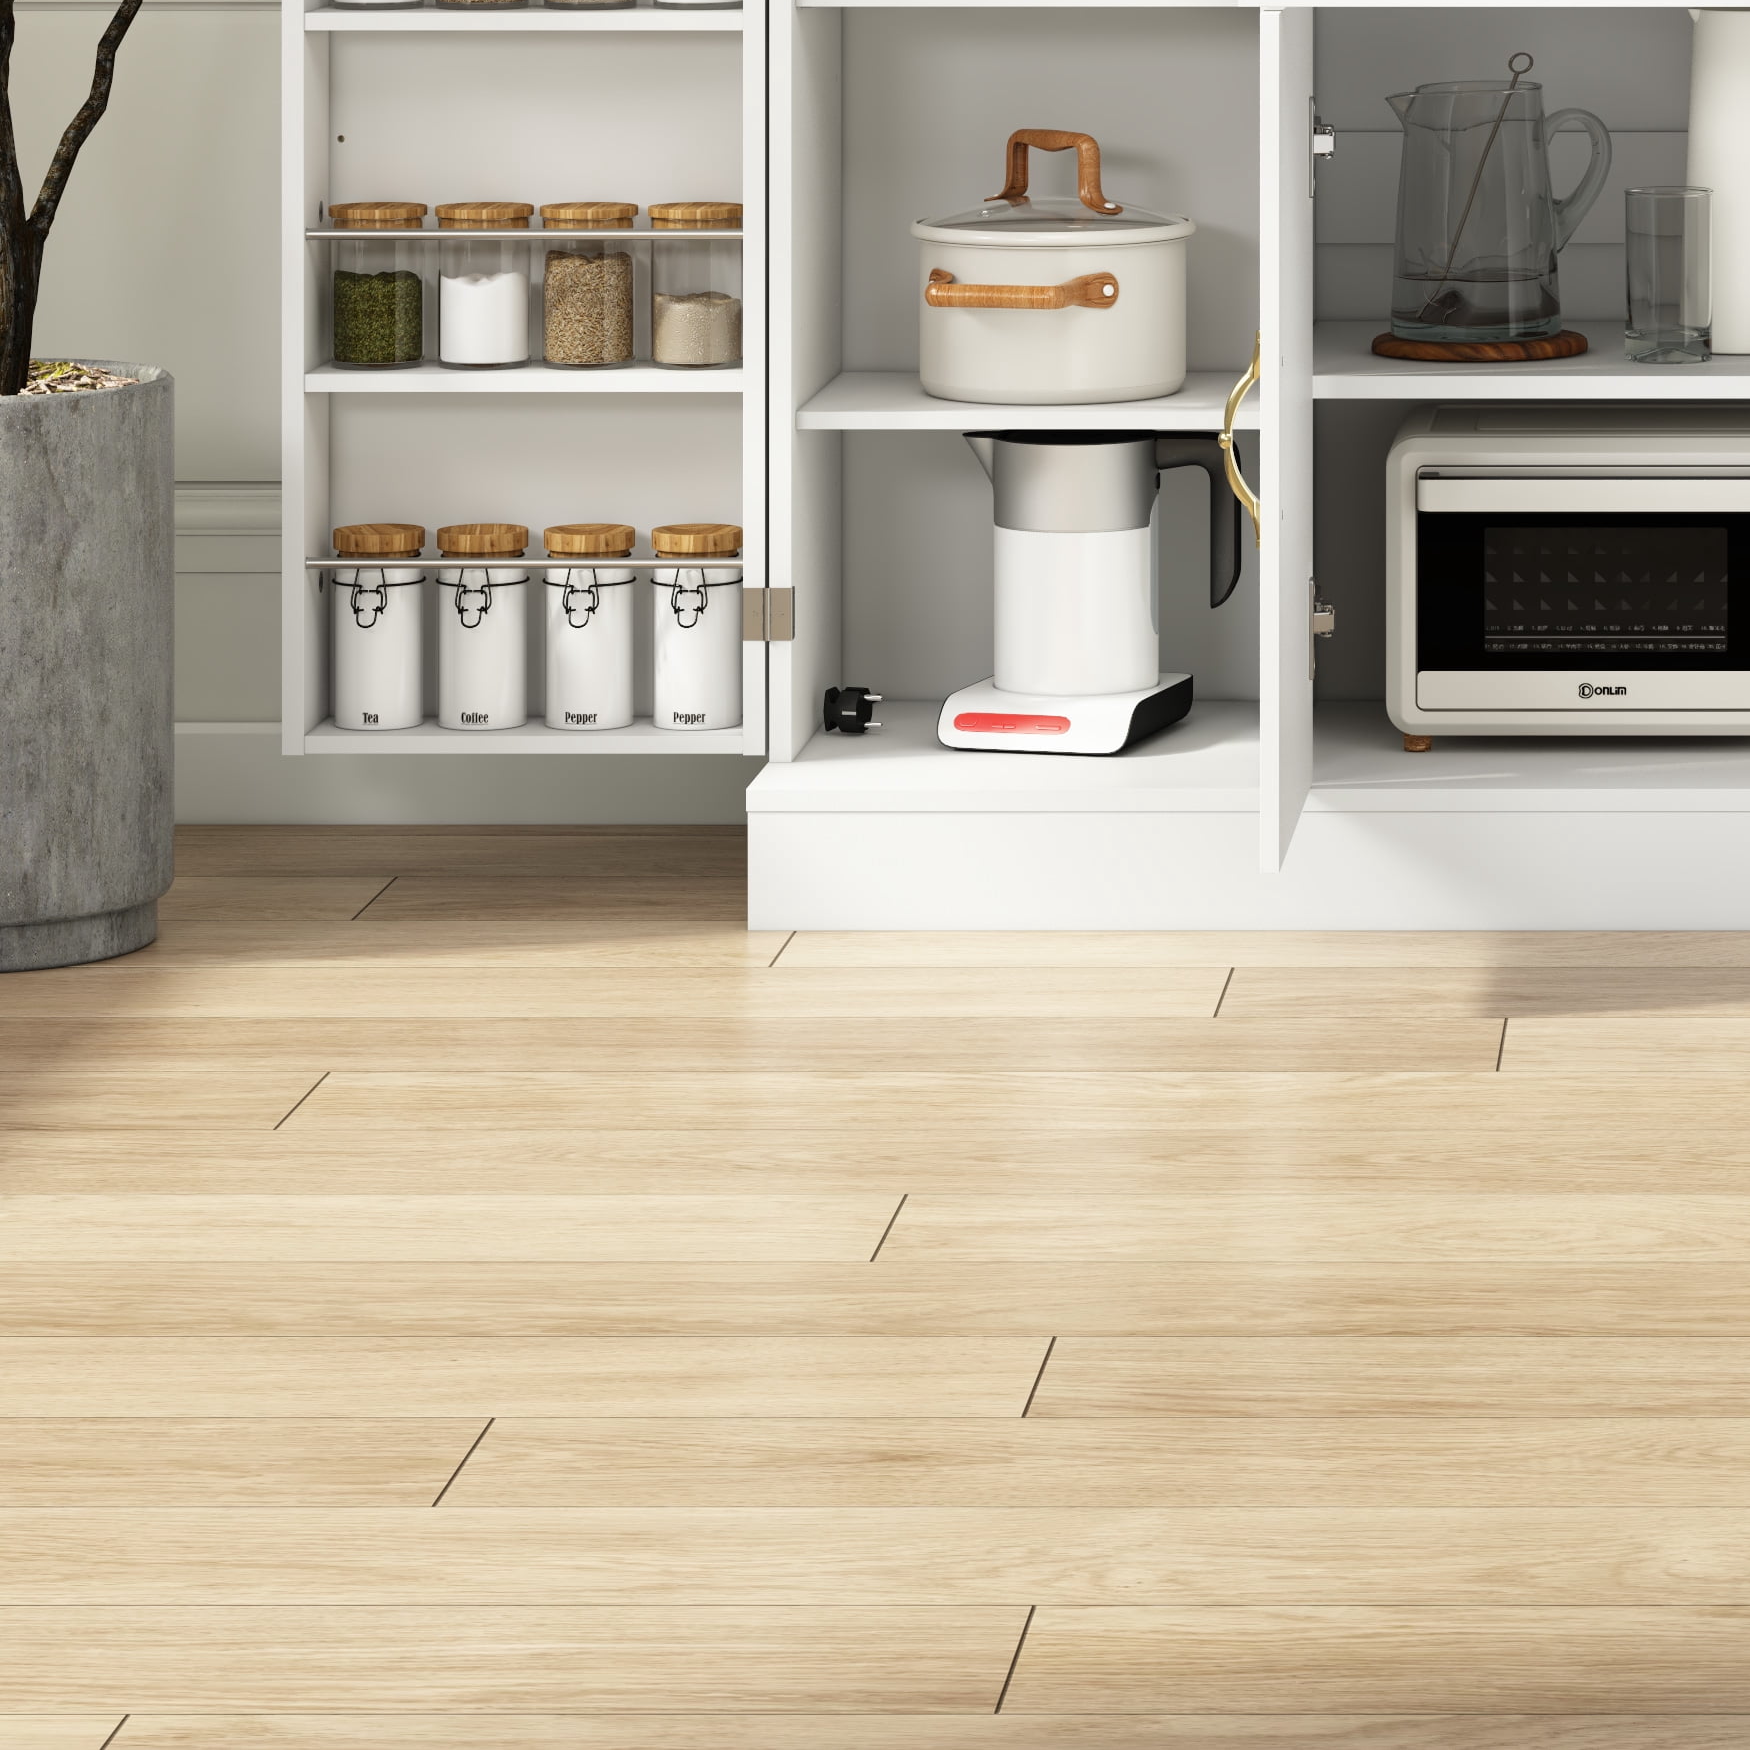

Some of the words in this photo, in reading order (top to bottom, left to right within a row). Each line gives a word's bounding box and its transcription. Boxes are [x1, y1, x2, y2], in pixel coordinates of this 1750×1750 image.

[362, 712, 379, 723] Tea
[461, 711, 489, 723] Coffee
[565, 711, 598, 725] Pepper
[673, 711, 706, 725] Pepper
